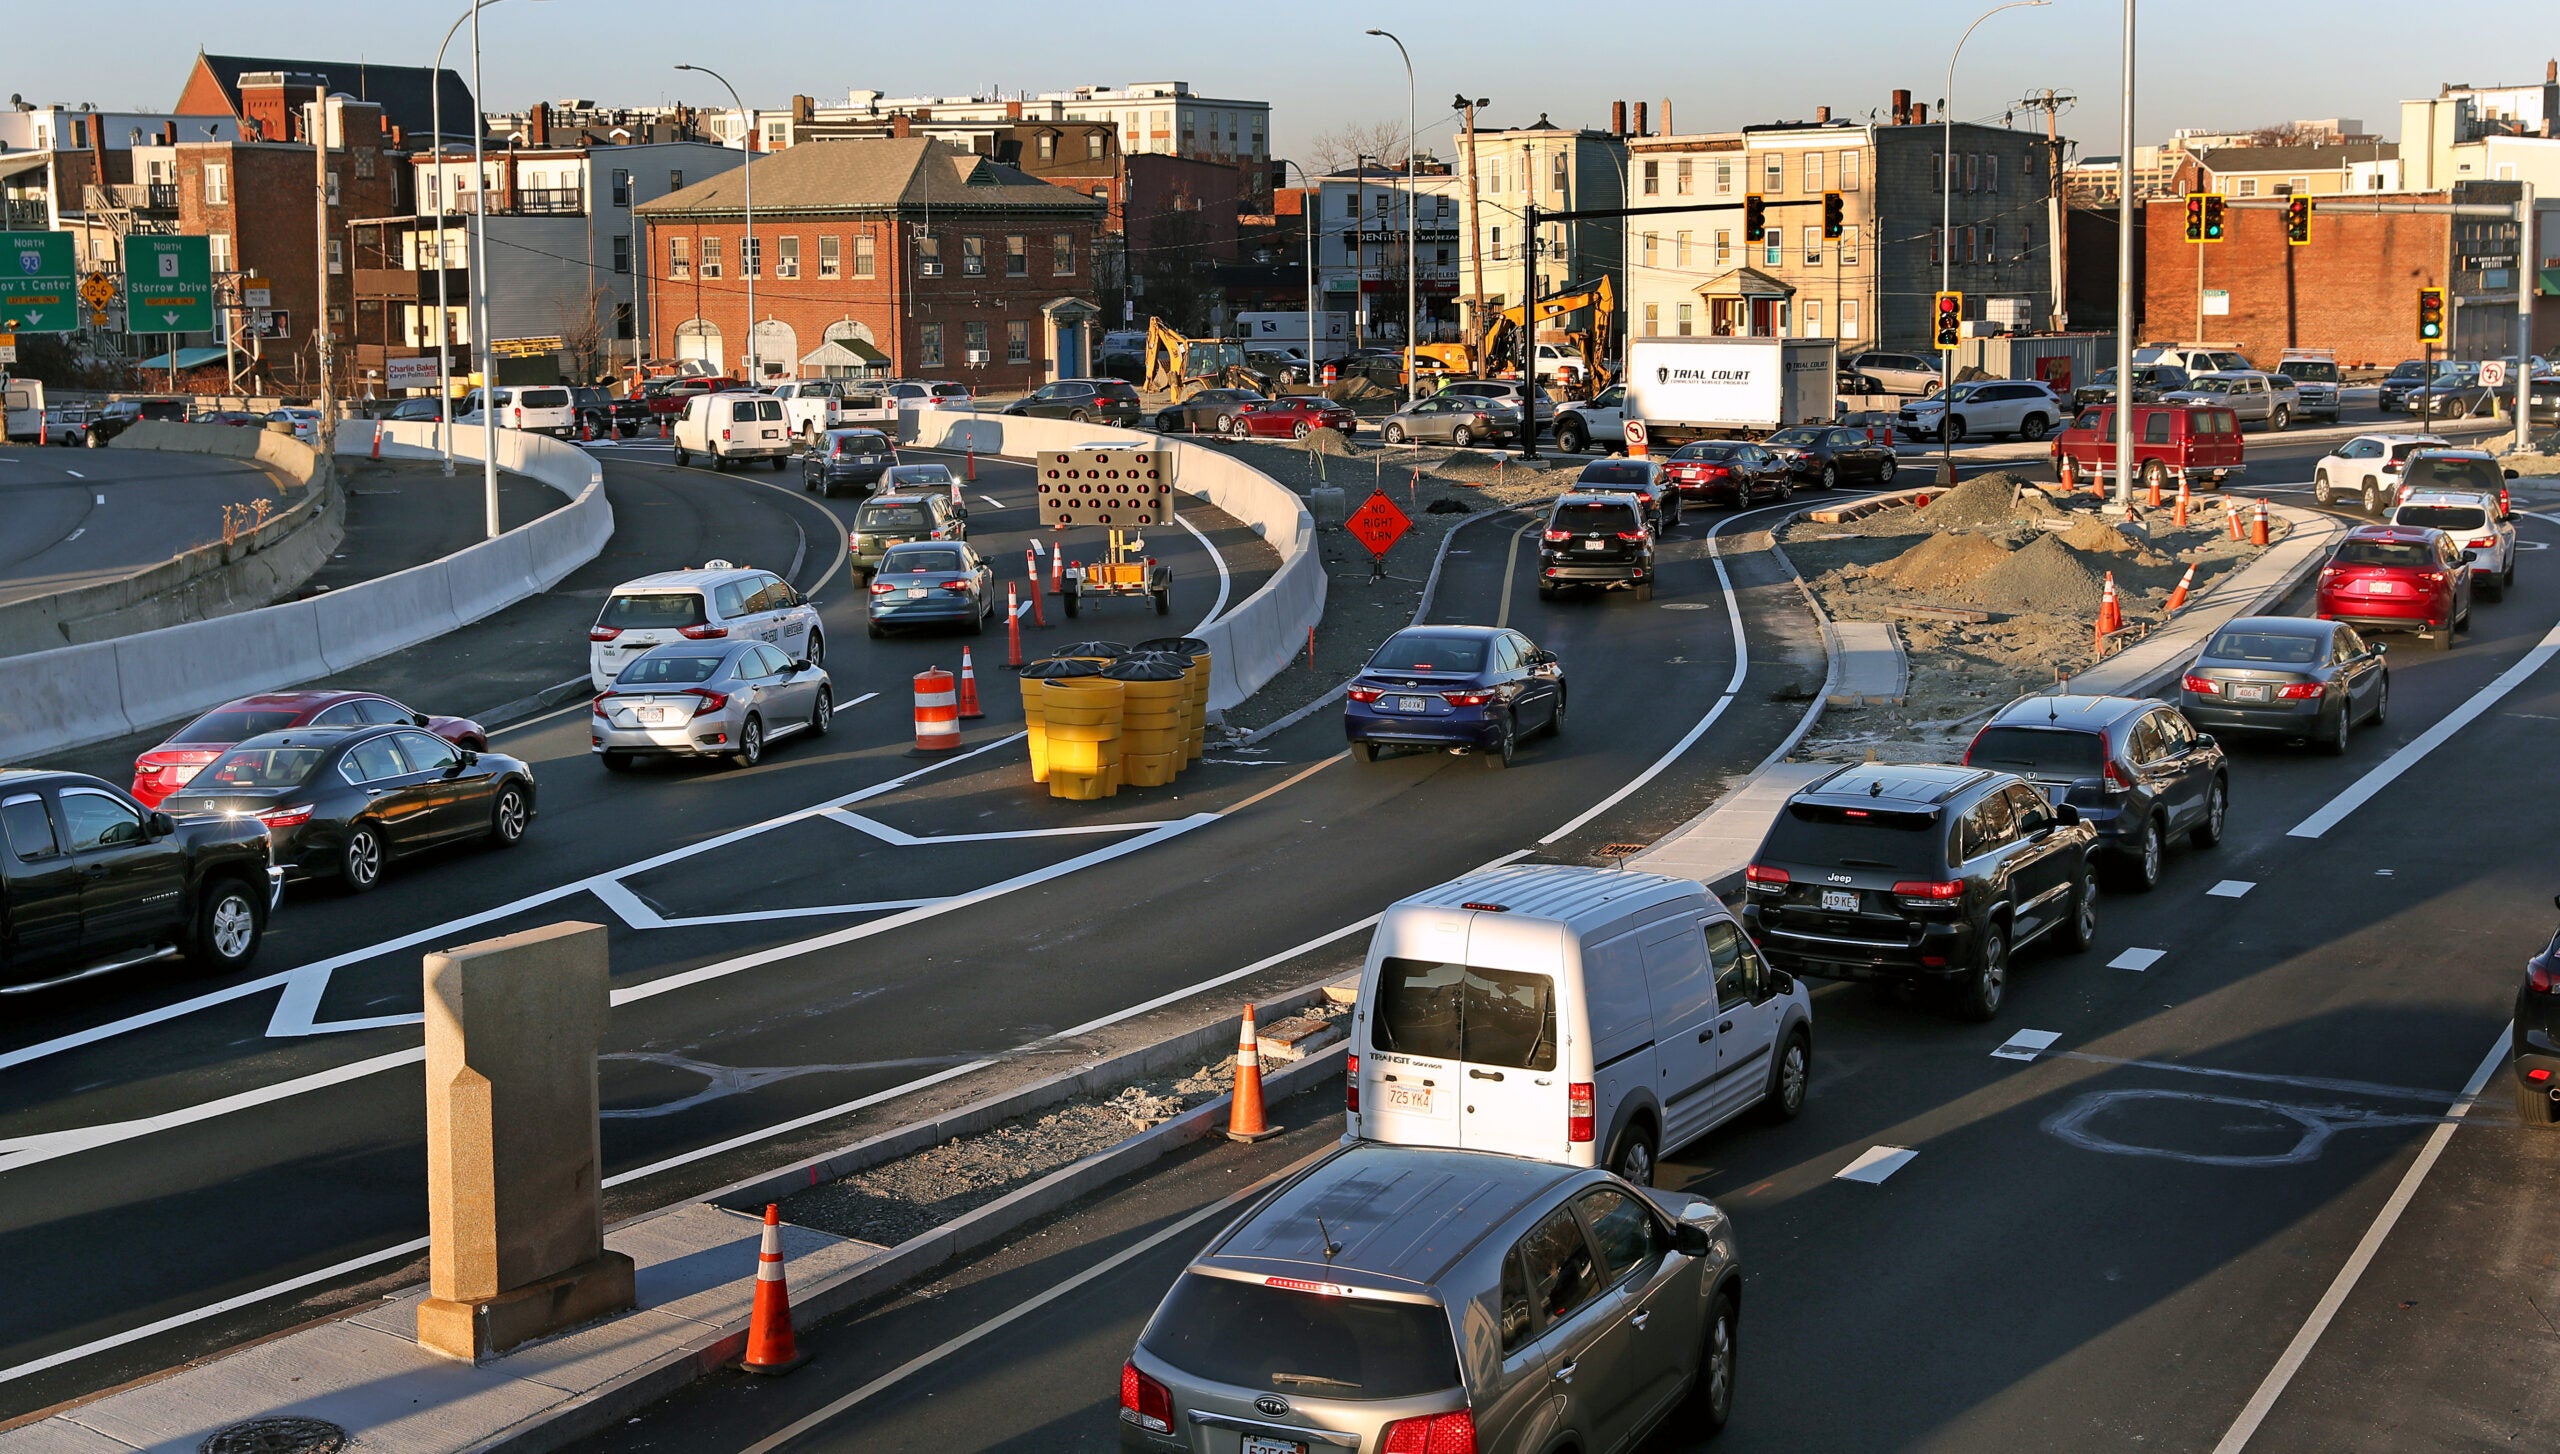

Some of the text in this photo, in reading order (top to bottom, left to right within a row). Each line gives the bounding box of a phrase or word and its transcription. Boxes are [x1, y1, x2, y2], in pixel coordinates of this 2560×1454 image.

[14, 238, 45, 248] NORTH
[153, 242, 182, 252] NORTH
[22, 256, 38, 270] 93
[165, 258, 173, 272] 3
[32, 280, 71, 291] Center
[86, 285, 107, 297] 12-6
[131, 282, 207, 293] Storrow Drive
[389, 363, 436, 373] Charlie Baker
[1673, 369, 1751, 381] TRIAL COURT
[1371, 504, 1386, 514] NO
[1363, 517, 1394, 529] RIGHT
[1365, 531, 1393, 541] TURN
[1827, 873, 1852, 884] Jeep
[1823, 896, 1858, 908] 419 KE3
[1369, 1052, 1411, 1065] TRANSIT
[1390, 1090, 1429, 1107] 725 YK4
[1258, 1401, 1284, 1414] KIA
